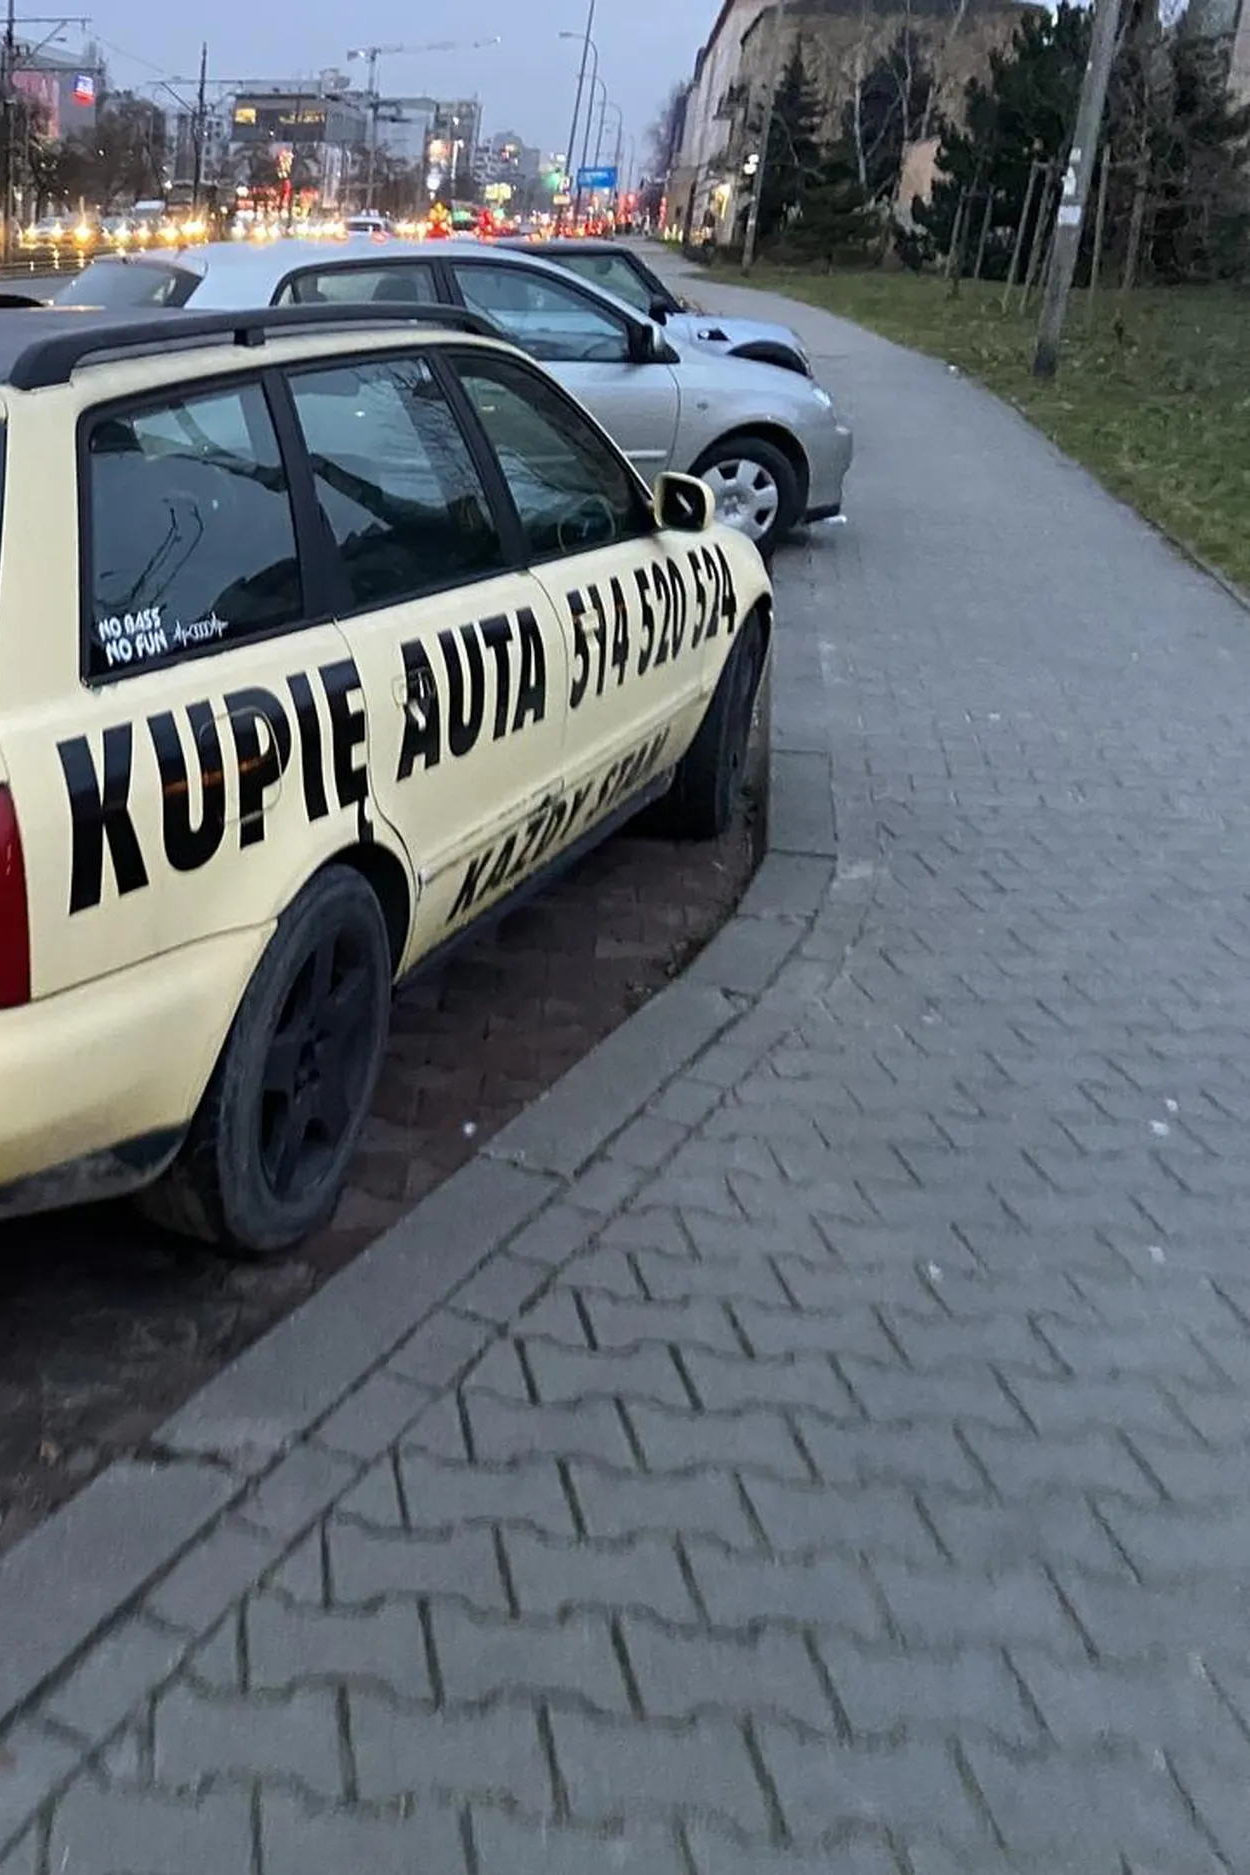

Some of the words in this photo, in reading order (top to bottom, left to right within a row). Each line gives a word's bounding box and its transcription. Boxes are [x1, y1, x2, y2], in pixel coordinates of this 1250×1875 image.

[99, 616, 122, 642] NO
[124, 606, 161, 635] BASS
[105, 638, 132, 667] NO
[135, 628, 168, 658] FUN
[396, 606, 546, 783] AUTA
[567, 575, 629, 709] 514
[634, 557, 686, 676] 520
[687, 543, 737, 649] 524
